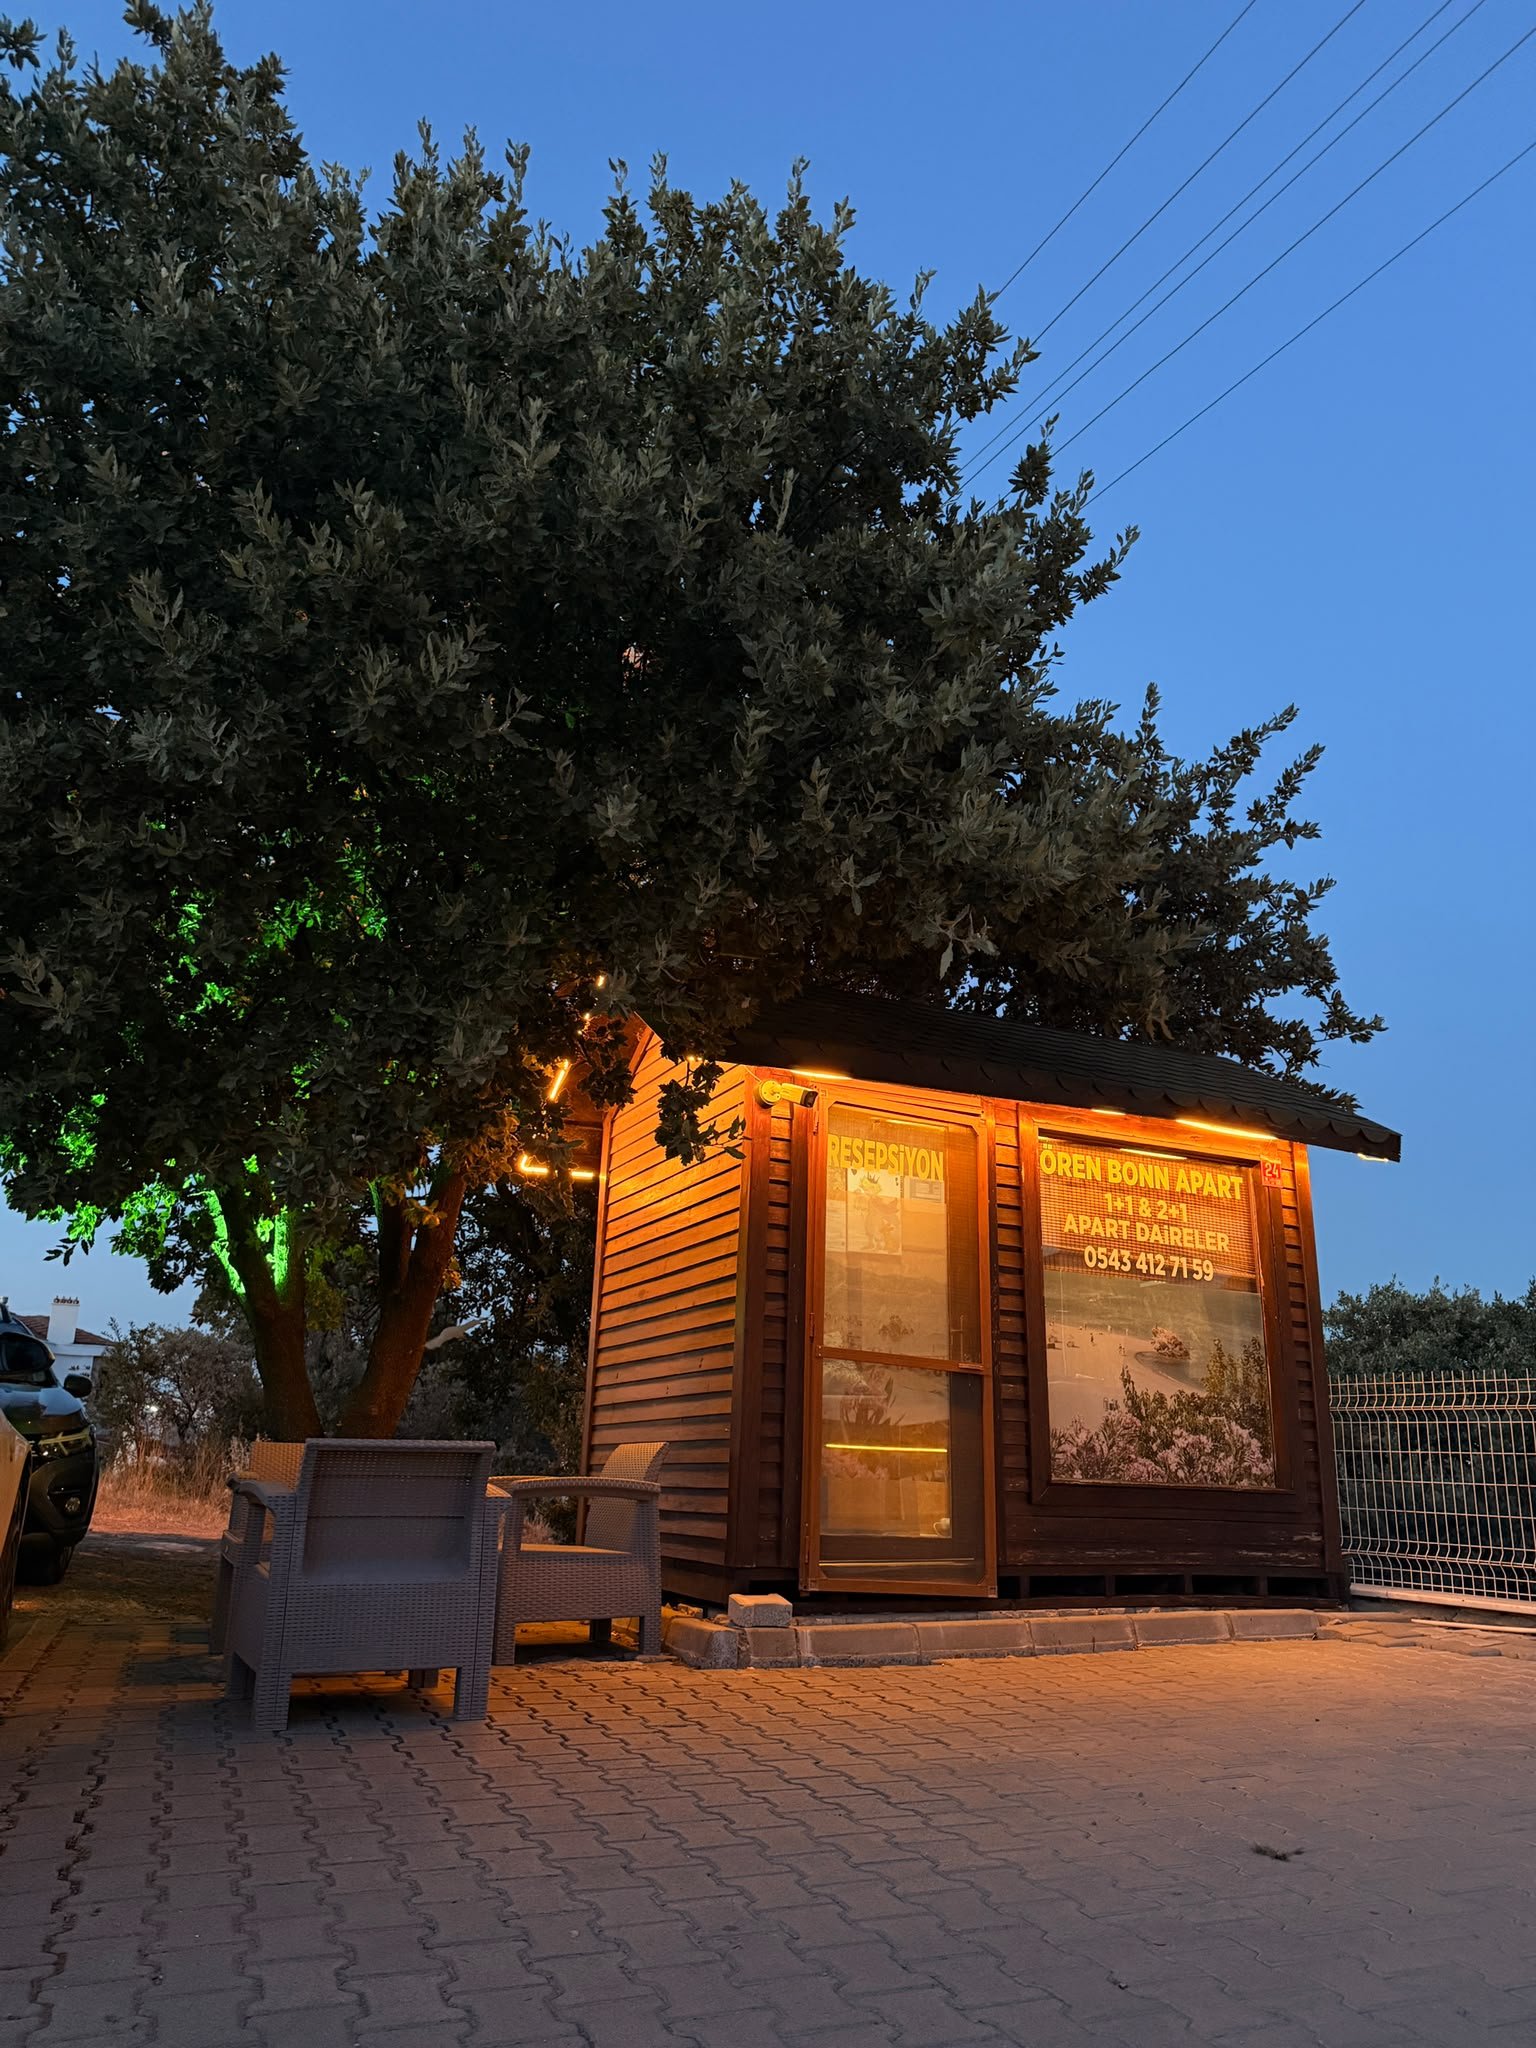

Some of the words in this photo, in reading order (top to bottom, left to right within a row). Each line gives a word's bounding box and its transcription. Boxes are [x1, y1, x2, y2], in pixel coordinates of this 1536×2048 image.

[1040, 1144, 1101, 1181] ÖREN
[1107, 1159, 1170, 1190] BONN
[1176, 1169, 1243, 1200] APART
[1264, 1162, 1280, 1178] 24
[1104, 1193, 1133, 1213] 1+1
[1138, 1199, 1152, 1218] &
[1157, 1200, 1188, 1222] 2+1
[1064, 1214, 1130, 1241] APART
[1083, 1245, 1132, 1272] 0543
[1135, 1253, 1166, 1276] 412
[1170, 1255, 1189, 1279] 71
[1192, 1260, 1214, 1282] 59
